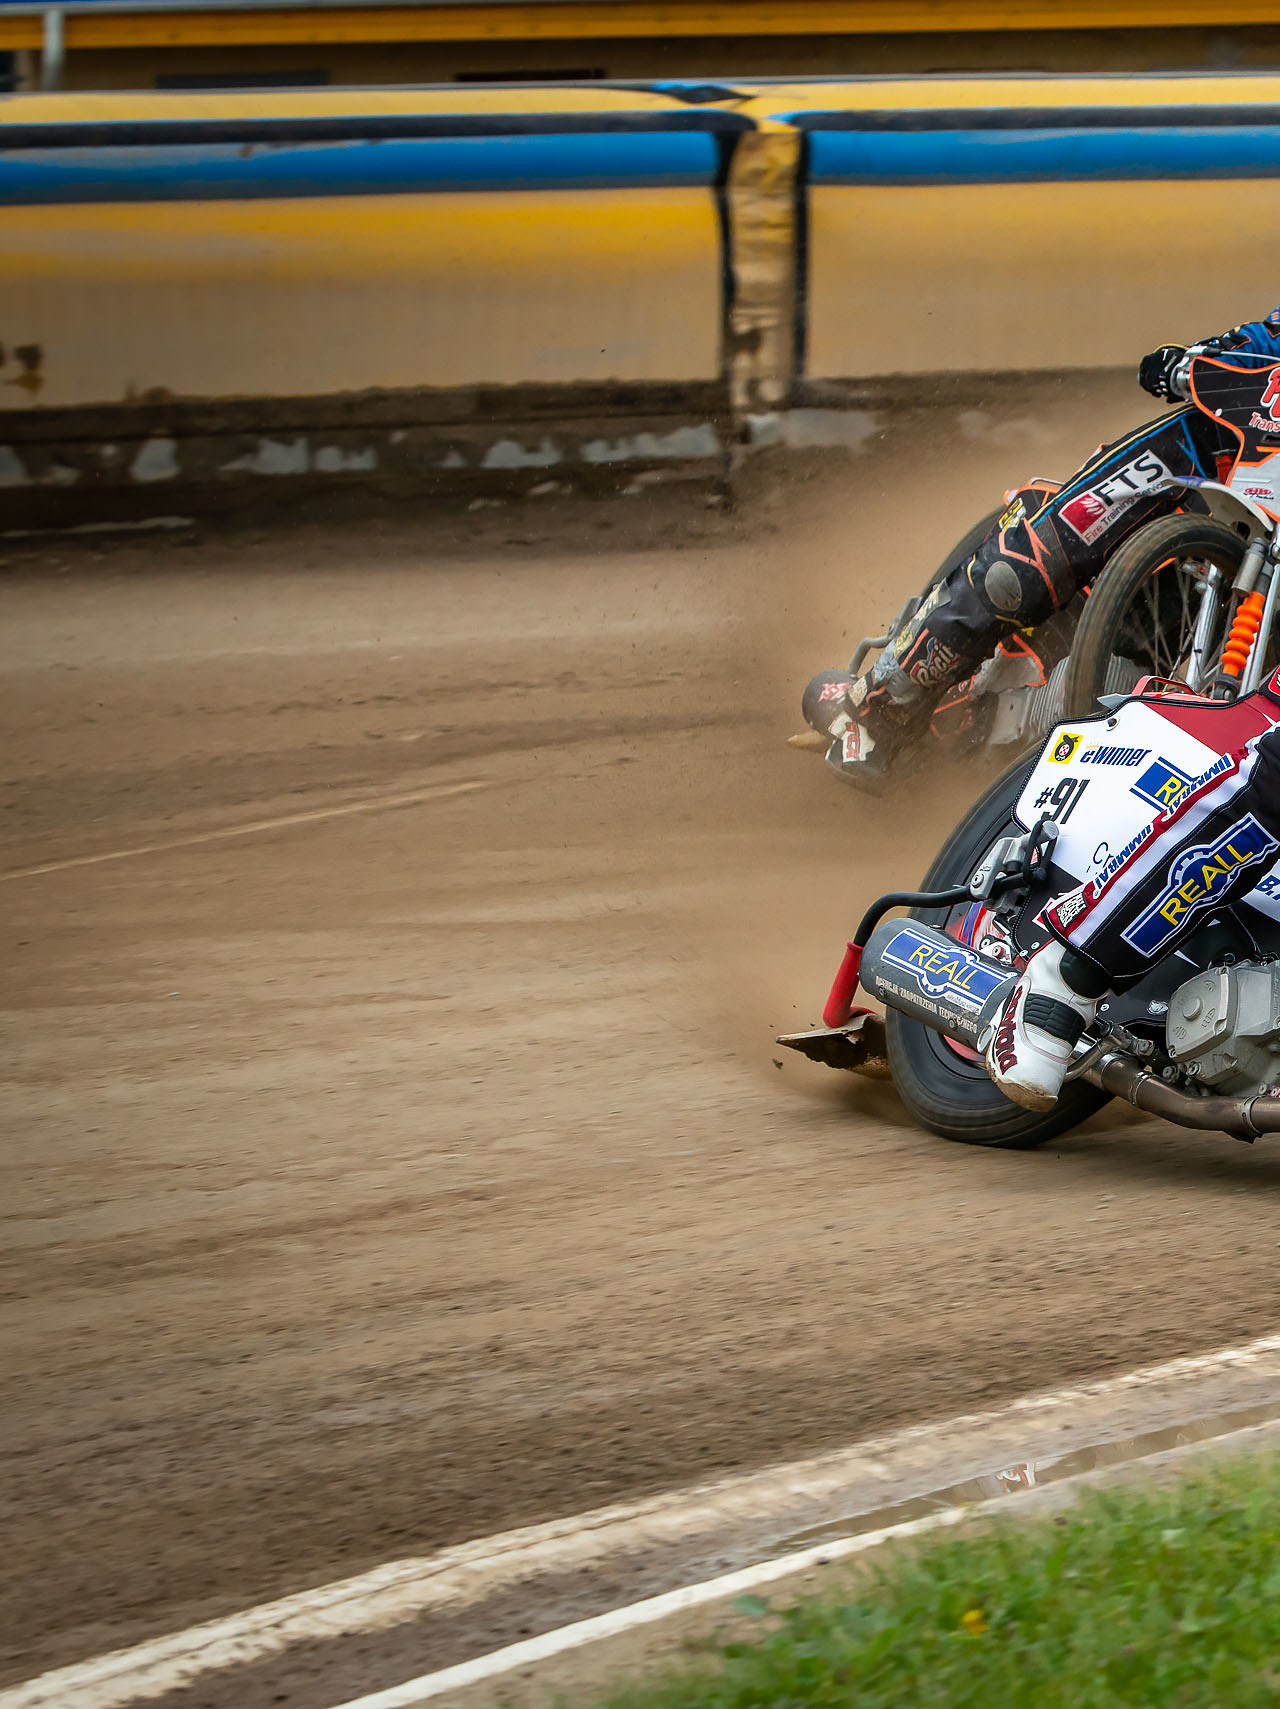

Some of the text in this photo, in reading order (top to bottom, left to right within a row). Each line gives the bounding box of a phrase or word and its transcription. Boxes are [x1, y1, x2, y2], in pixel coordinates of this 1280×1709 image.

[1092, 455, 1163, 507] FTS
[1084, 482, 1165, 542] Fire Training Servic
[1033, 778, 1090, 824] #91
[1160, 844, 1253, 926] REALL
[908, 944, 978, 990] REALL
